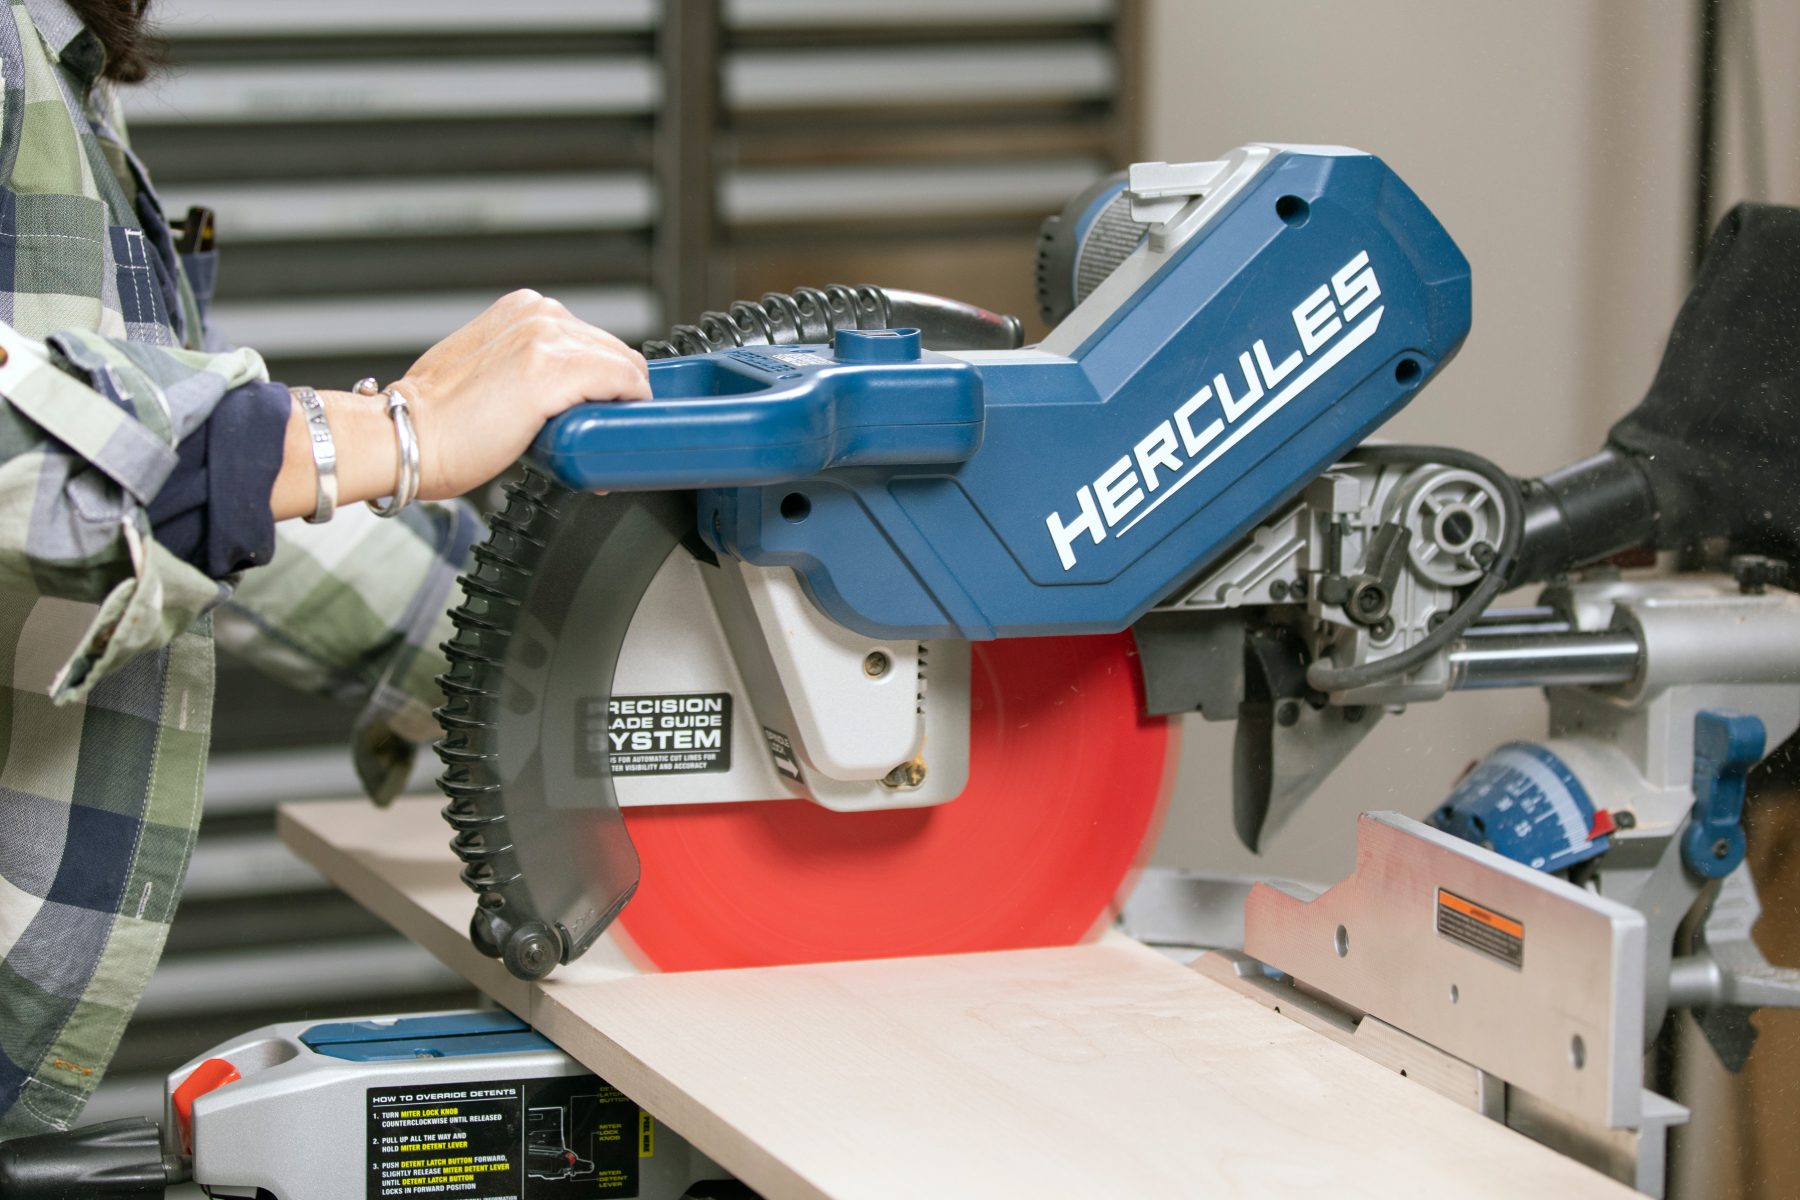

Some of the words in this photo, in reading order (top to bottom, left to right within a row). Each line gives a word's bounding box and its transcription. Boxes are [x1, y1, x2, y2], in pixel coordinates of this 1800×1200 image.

[1046, 250, 1382, 571] HERCULES
[609, 698, 722, 715] RECISION
[608, 717, 654, 729] ADE
[661, 714, 722, 728] GUIDE
[608, 729, 721, 751] YSTEM
[625, 763, 658, 771] VISIBILITY
[674, 762, 707, 770] ACCURACY
[416, 1092, 467, 1101] OVERRIDE
[470, 1089, 516, 1097] DETENTS
[382, 1111, 399, 1119] TURN
[400, 1110, 421, 1118] MITER
[382, 1118, 448, 1128] COUNTERCLOCKWISE
[469, 1114, 502, 1122] RELEASED
[401, 1143, 420, 1152] MITER
[422, 1142, 446, 1150] DETENT
[401, 1160, 425, 1168] DETENT
[448, 1157, 472, 1165] BUTTON
[474, 1154, 507, 1163] FORWARD,
[382, 1169, 411, 1178] SLIGHTLY
[413, 1168, 441, 1176] RELEASE
[443, 1166, 462, 1174] MITER
[464, 1165, 488, 1173] DETENT
[382, 1179, 400, 1187] UNTIL
[401, 1177, 426, 1185] DETENT
[449, 1174, 474, 1182] BUTTON
[382, 1187, 403, 1195] LOCKS
[413, 1185, 445, 1193] FORWARD
[446, 1183, 476, 1191] POSITION
